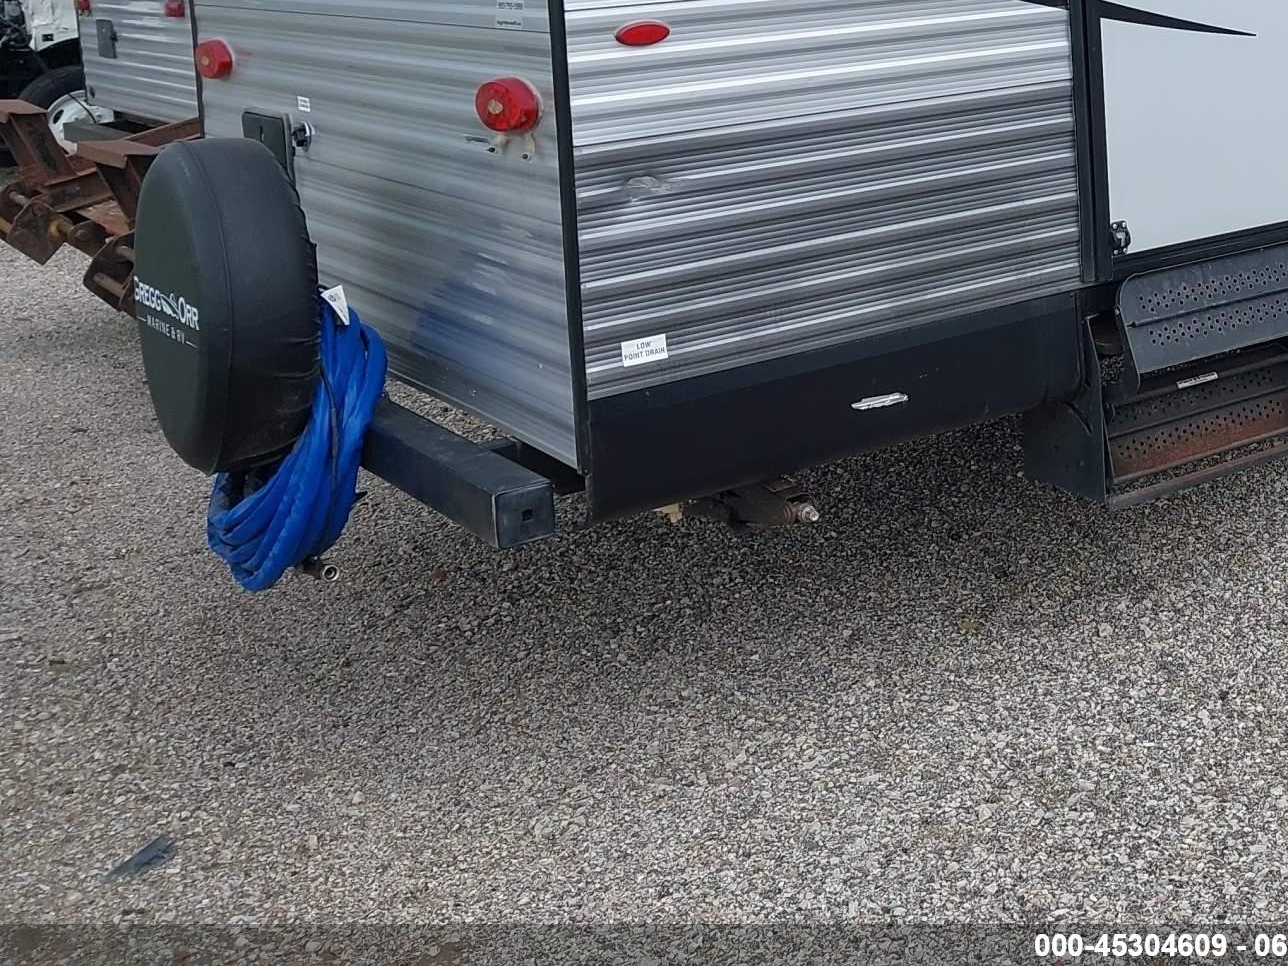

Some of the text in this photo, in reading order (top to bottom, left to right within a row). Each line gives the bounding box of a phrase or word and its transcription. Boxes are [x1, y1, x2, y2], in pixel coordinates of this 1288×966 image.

[134, 275, 200, 331] GREGG ORR
[146, 314, 170, 337] MARINE
[623, 346, 666, 361] POINT DRAIN
[636, 340, 652, 350] LOW
